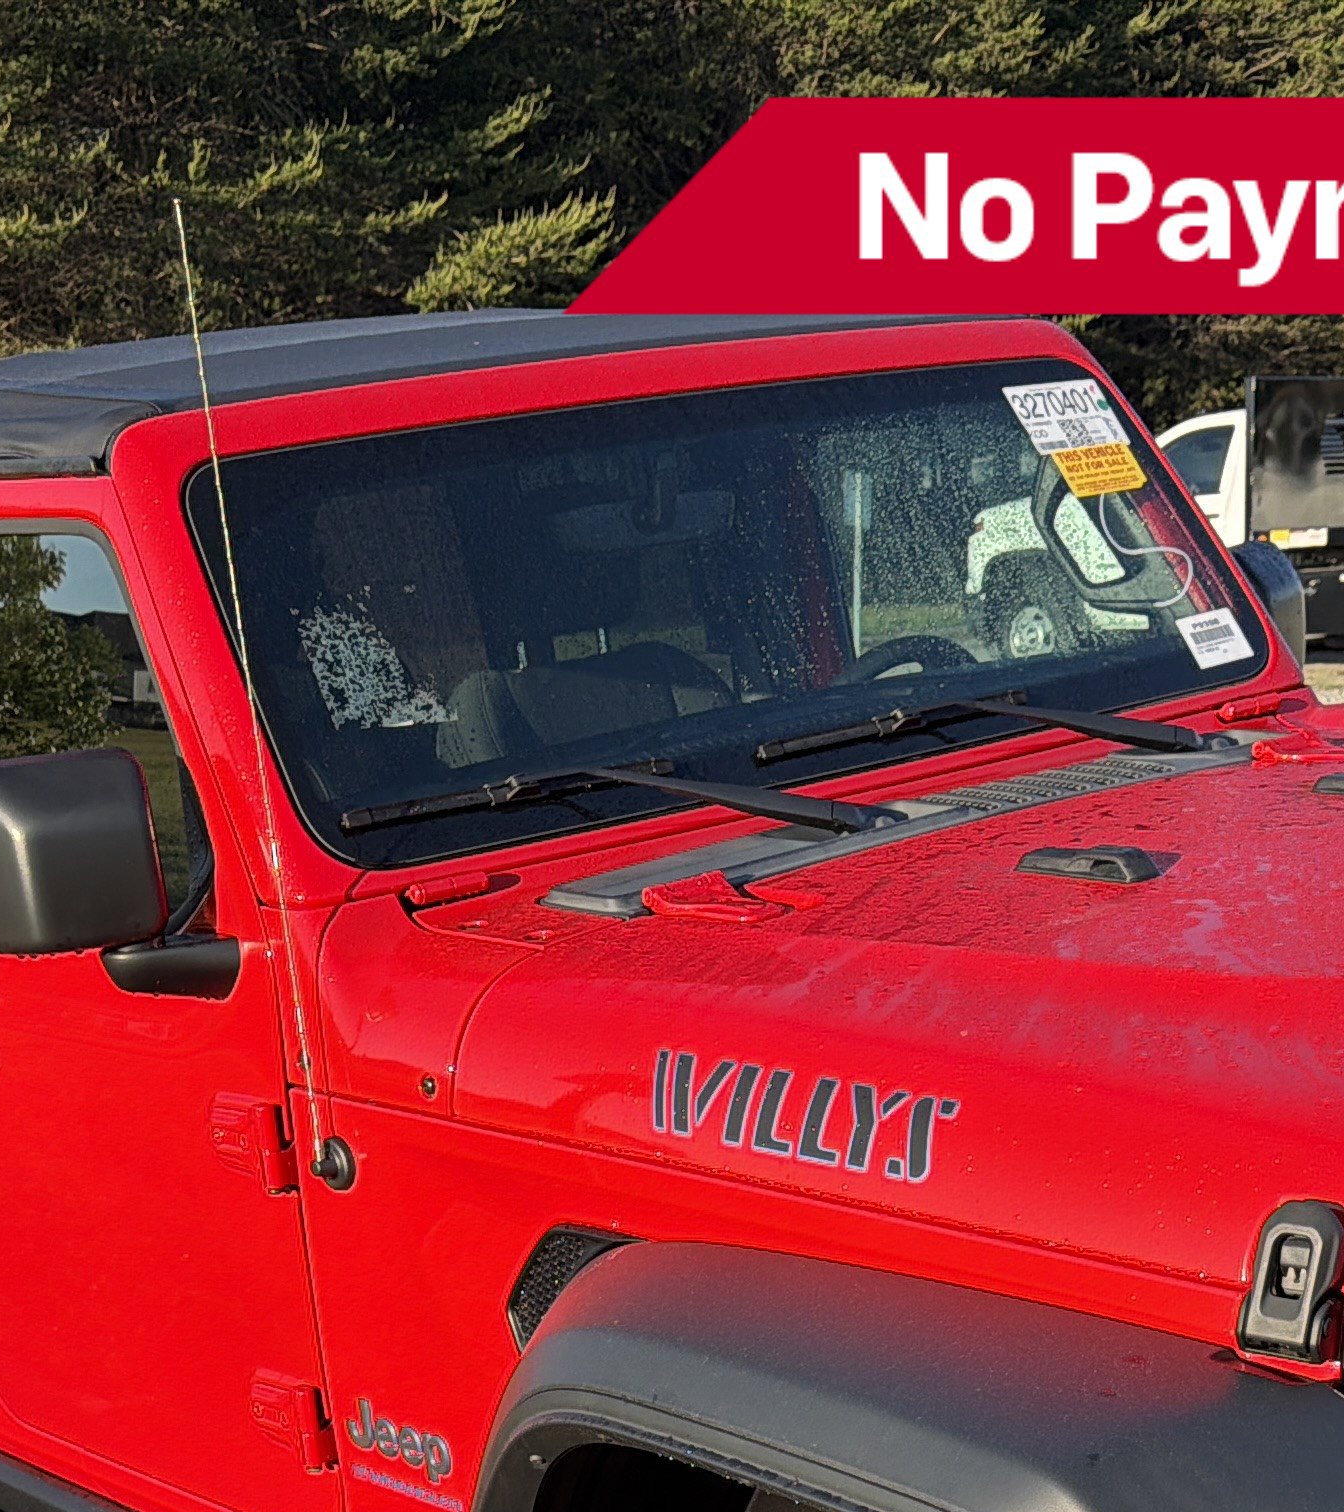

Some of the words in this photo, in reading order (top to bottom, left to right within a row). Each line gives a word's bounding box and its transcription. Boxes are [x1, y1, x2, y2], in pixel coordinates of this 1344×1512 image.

[1013, 388, 1099, 419] 3270401
[1055, 450, 1083, 464] THIS
[1083, 444, 1126, 460] VEHICLE
[1065, 461, 1086, 474] NOT
[1086, 459, 1105, 471] FOR
[1105, 456, 1131, 468] SALE
[653, 1048, 961, 1183] WILLYS
[346, 1397, 452, 1484] Jeep
